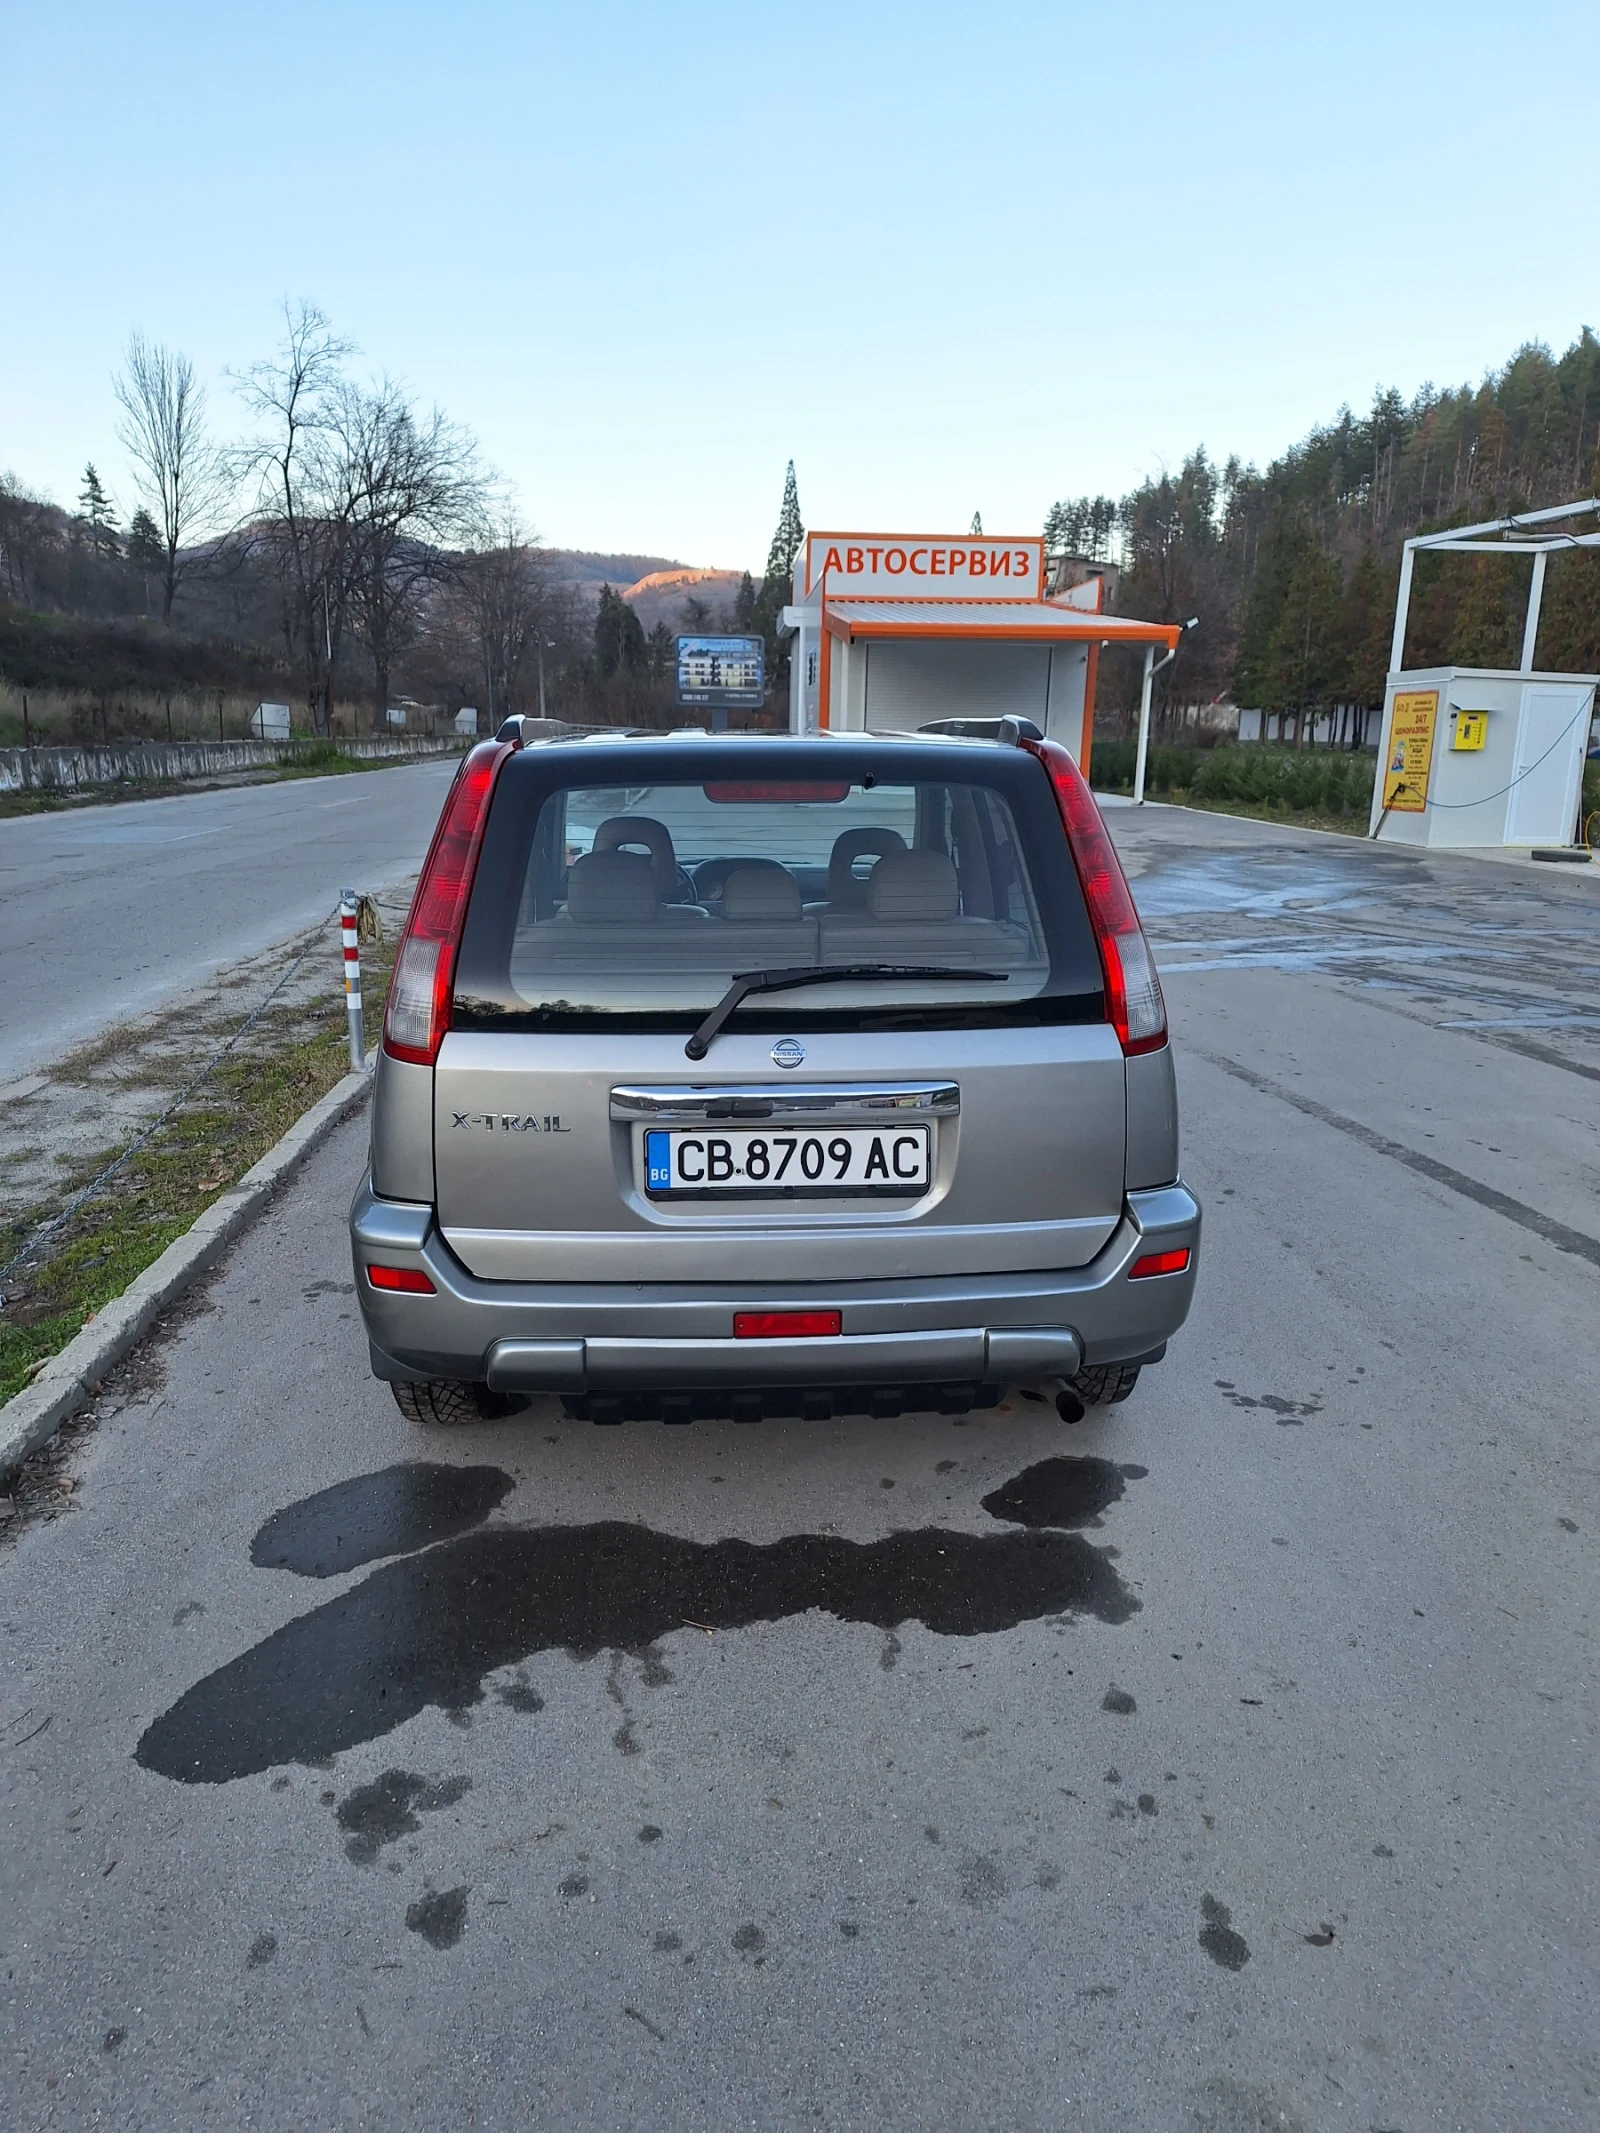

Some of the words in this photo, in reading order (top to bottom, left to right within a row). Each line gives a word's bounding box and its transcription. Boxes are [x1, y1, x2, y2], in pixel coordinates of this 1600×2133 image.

[823, 547, 1030, 577] АВТОСЕРВИЗ
[450, 1111, 571, 1132] X-TRAIL
[677, 1139, 734, 1182] CB
[746, 1137, 853, 1181] 8709
[864, 1136, 920, 1180] AC
[651, 1168, 669, 1181] BG
